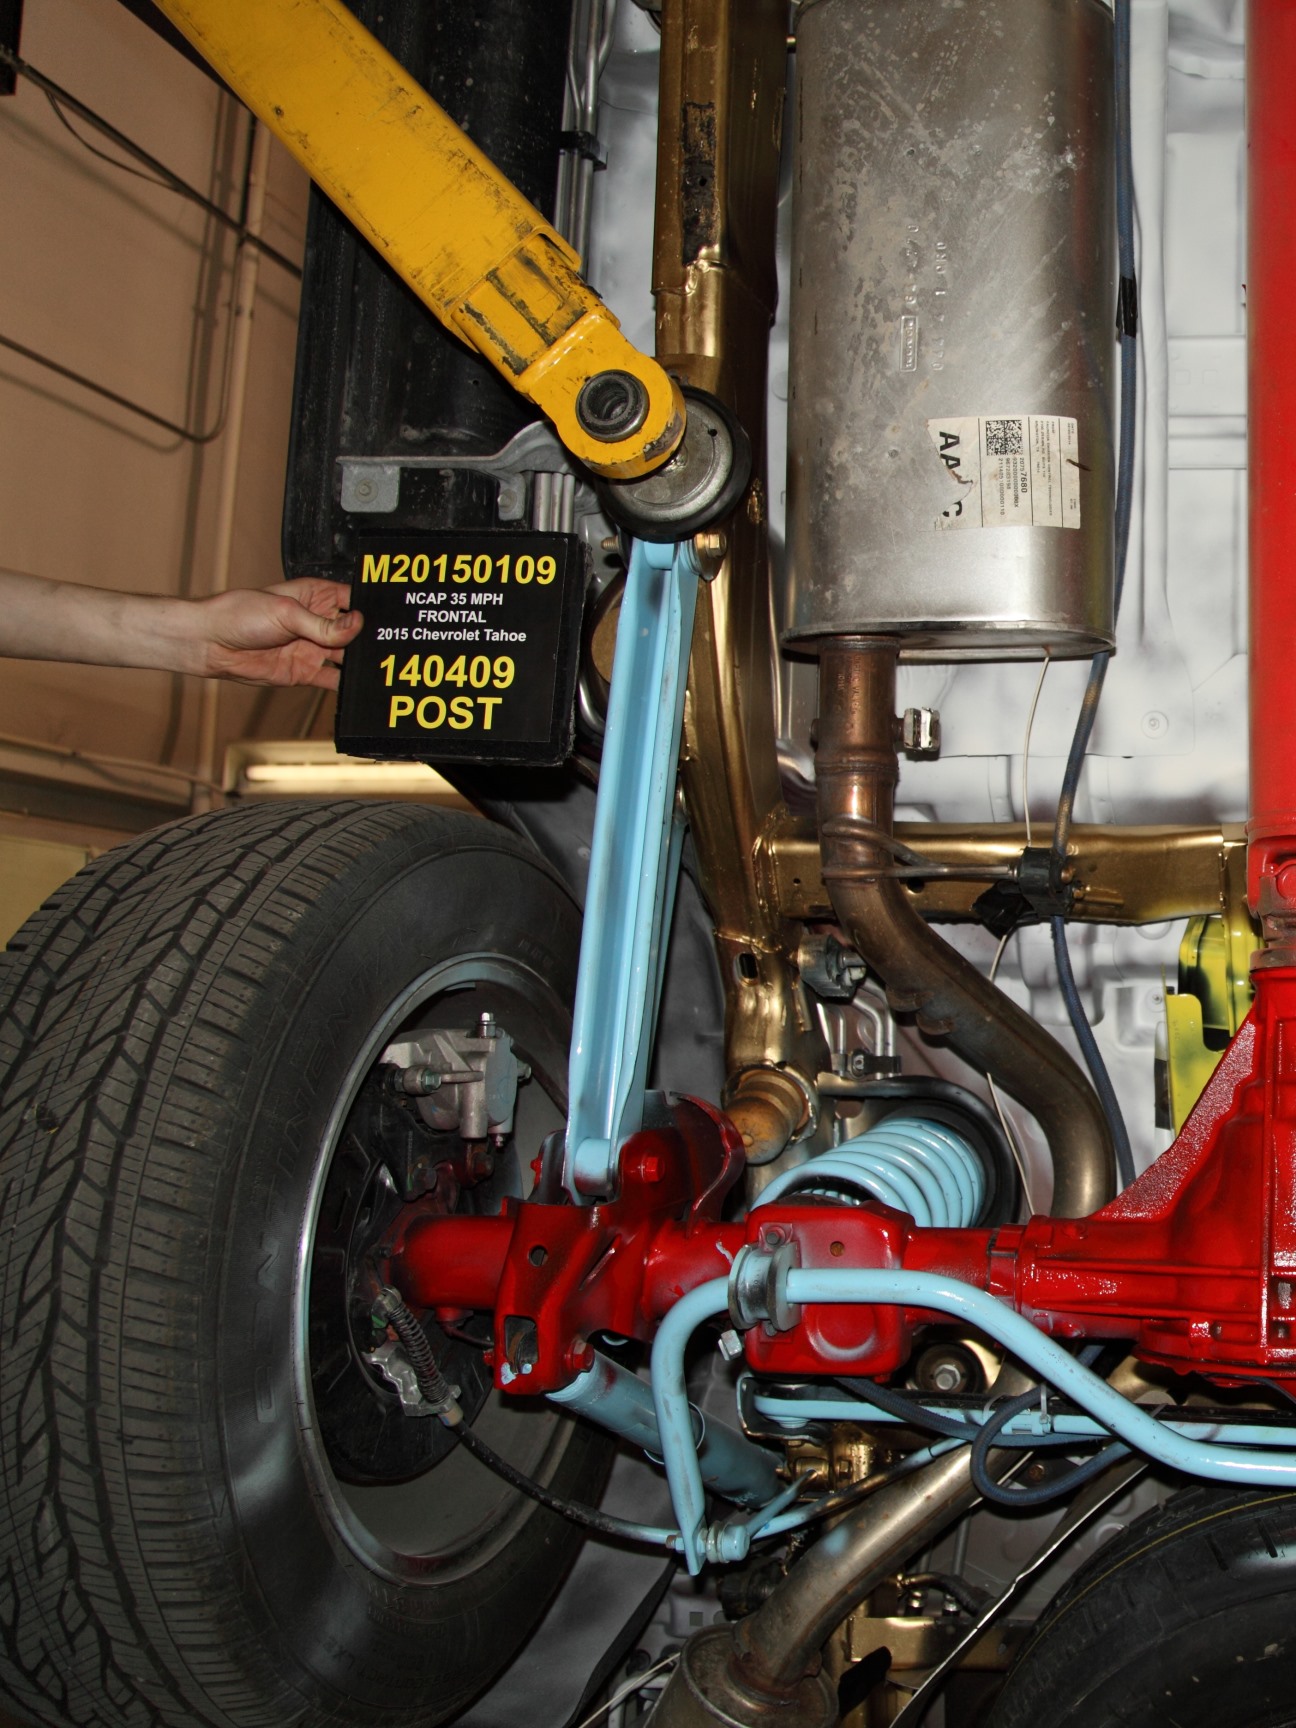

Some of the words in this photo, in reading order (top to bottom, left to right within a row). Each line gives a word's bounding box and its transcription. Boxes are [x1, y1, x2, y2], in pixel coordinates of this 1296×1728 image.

[361, 554, 557, 585] M20150109
[405, 592, 447, 605] NCAP
[450, 593, 467, 605] 35
[470, 593, 504, 606] MPH
[417, 610, 487, 623] FRONTAL
[377, 628, 409, 640] 2015
[412, 628, 480, 641] Chevrolet
[484, 629, 527, 642] Tahoe
[379, 654, 516, 689] 140409
[388, 695, 503, 730] POST
